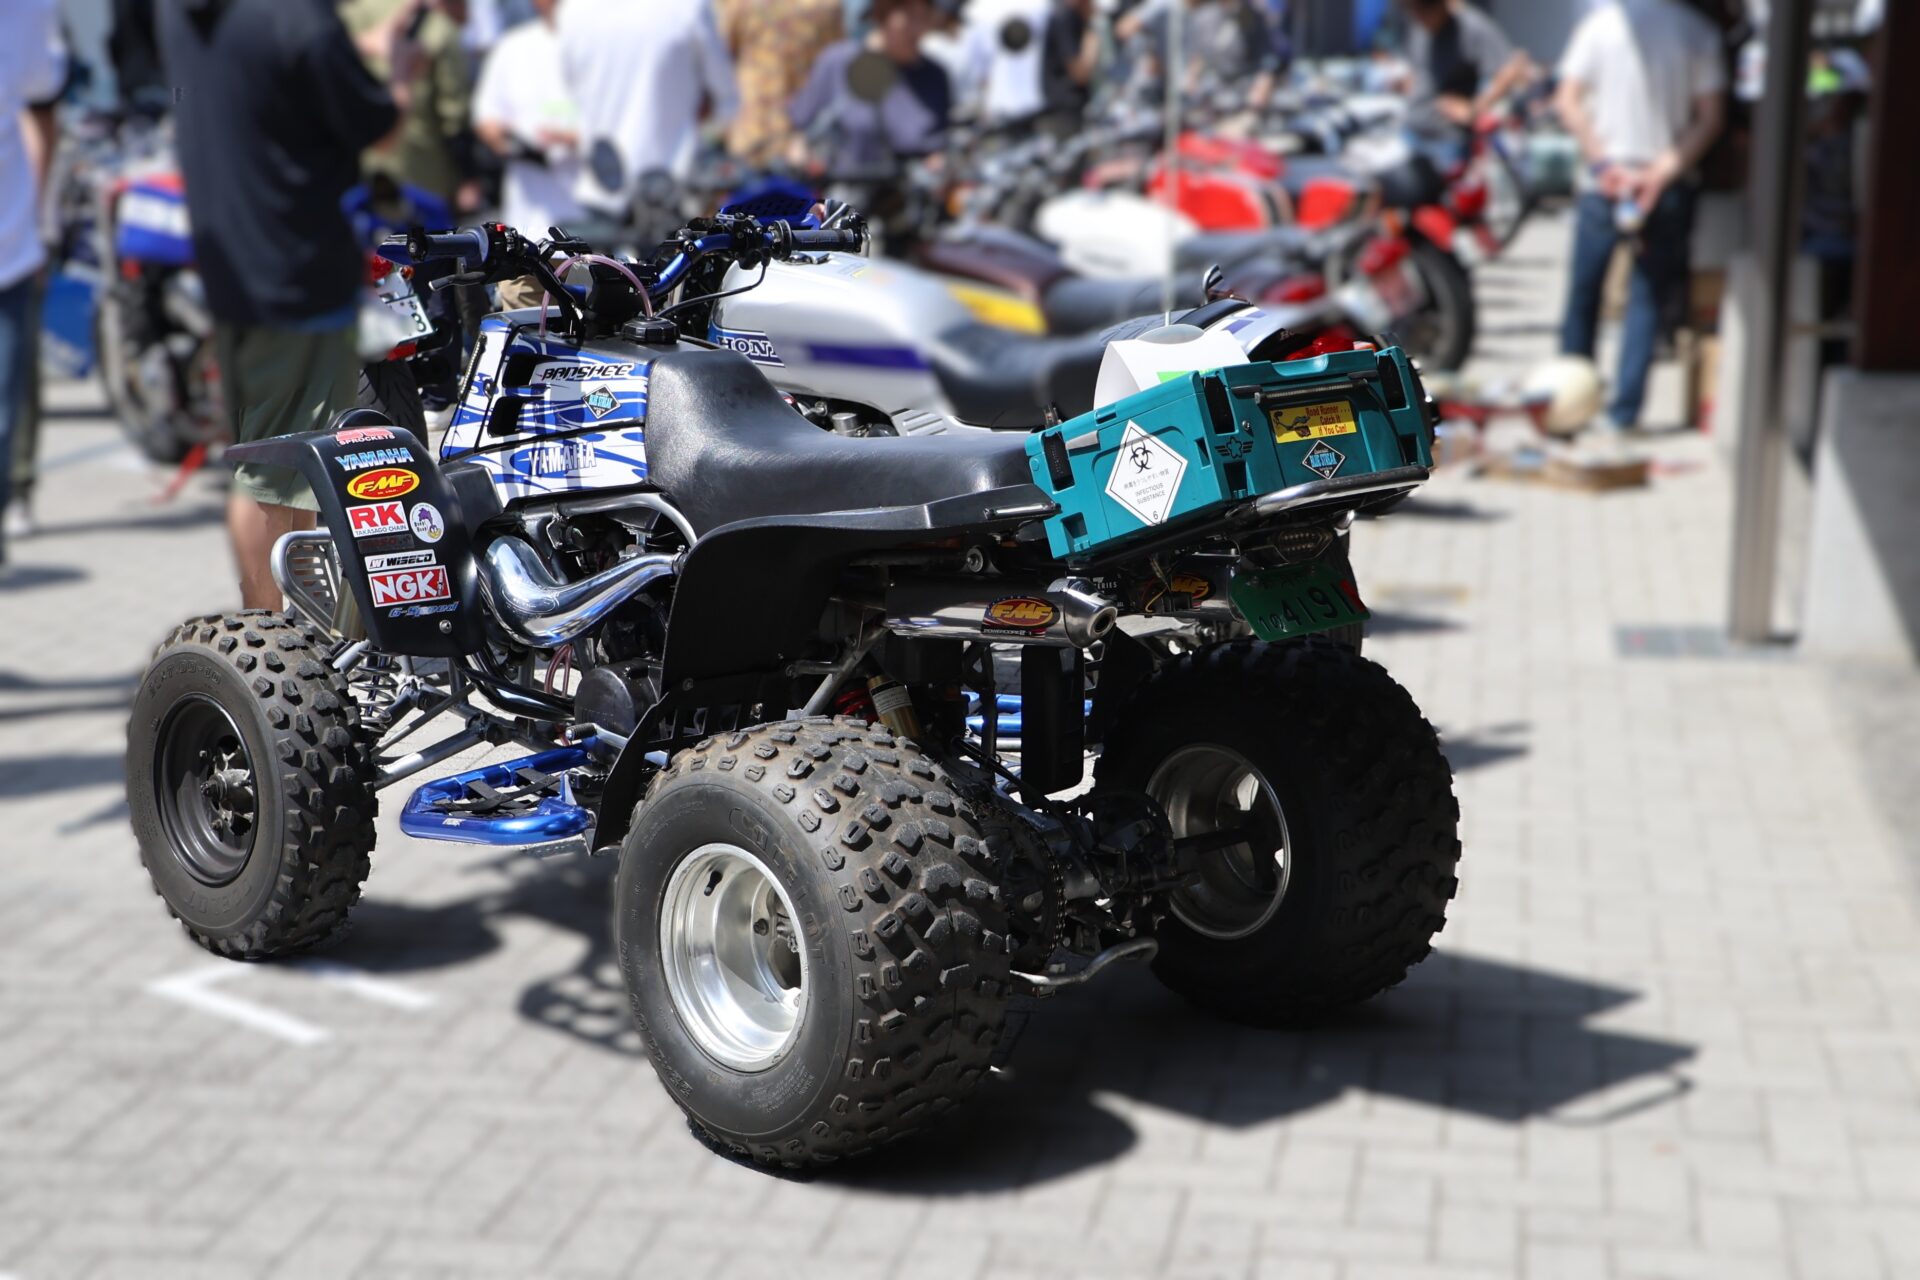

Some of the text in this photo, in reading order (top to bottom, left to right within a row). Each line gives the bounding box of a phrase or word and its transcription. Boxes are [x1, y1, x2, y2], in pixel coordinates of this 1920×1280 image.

[542, 364, 633, 381] BANSHEE
[1324, 424, 1335, 435] You
[339, 434, 396, 446] SPROCKETS
[334, 447, 415, 471] YAMAHA
[528, 441, 597, 475] YAMAHA
[356, 474, 413, 494] FMF
[1135, 482, 1164, 496] INFECTIOUS
[1137, 490, 1166, 504] SUBSTANCE
[350, 503, 405, 530] RK
[1153, 510, 1159, 520] 6
[355, 527, 387, 536] TAKASAGO
[372, 570, 438, 603] NGK
[993, 602, 1052, 619] FMF
